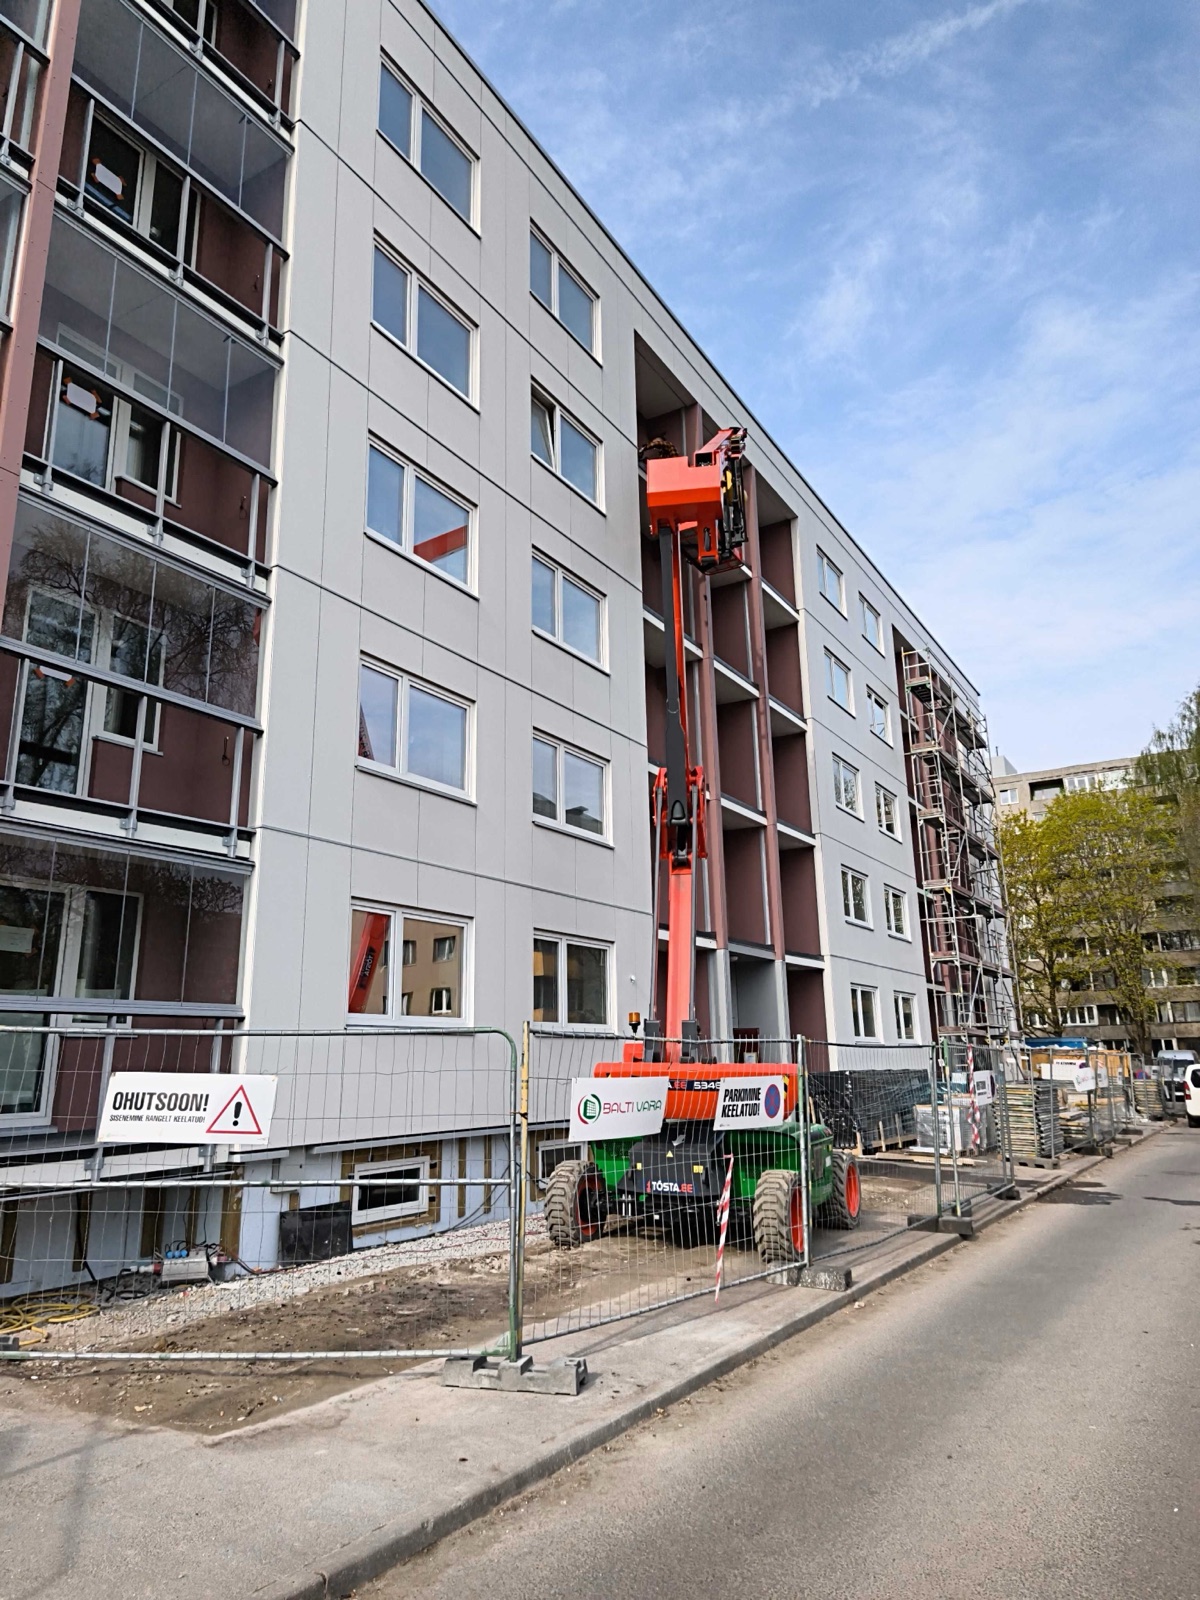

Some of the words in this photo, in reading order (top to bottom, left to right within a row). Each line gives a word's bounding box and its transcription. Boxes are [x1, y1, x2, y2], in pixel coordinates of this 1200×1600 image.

[112, 1091, 210, 1112] OHUTSOON!
[723, 1087, 762, 1103] PARKIMINE
[603, 1101, 635, 1114] BALTI
[636, 1099, 662, 1112] VARA
[721, 1102, 760, 1118] KEELATUD!
[109, 1114, 144, 1122] SISENEMINE
[145, 1114, 172, 1123] RANGELT
[173, 1115, 206, 1124] KEELATUD!
